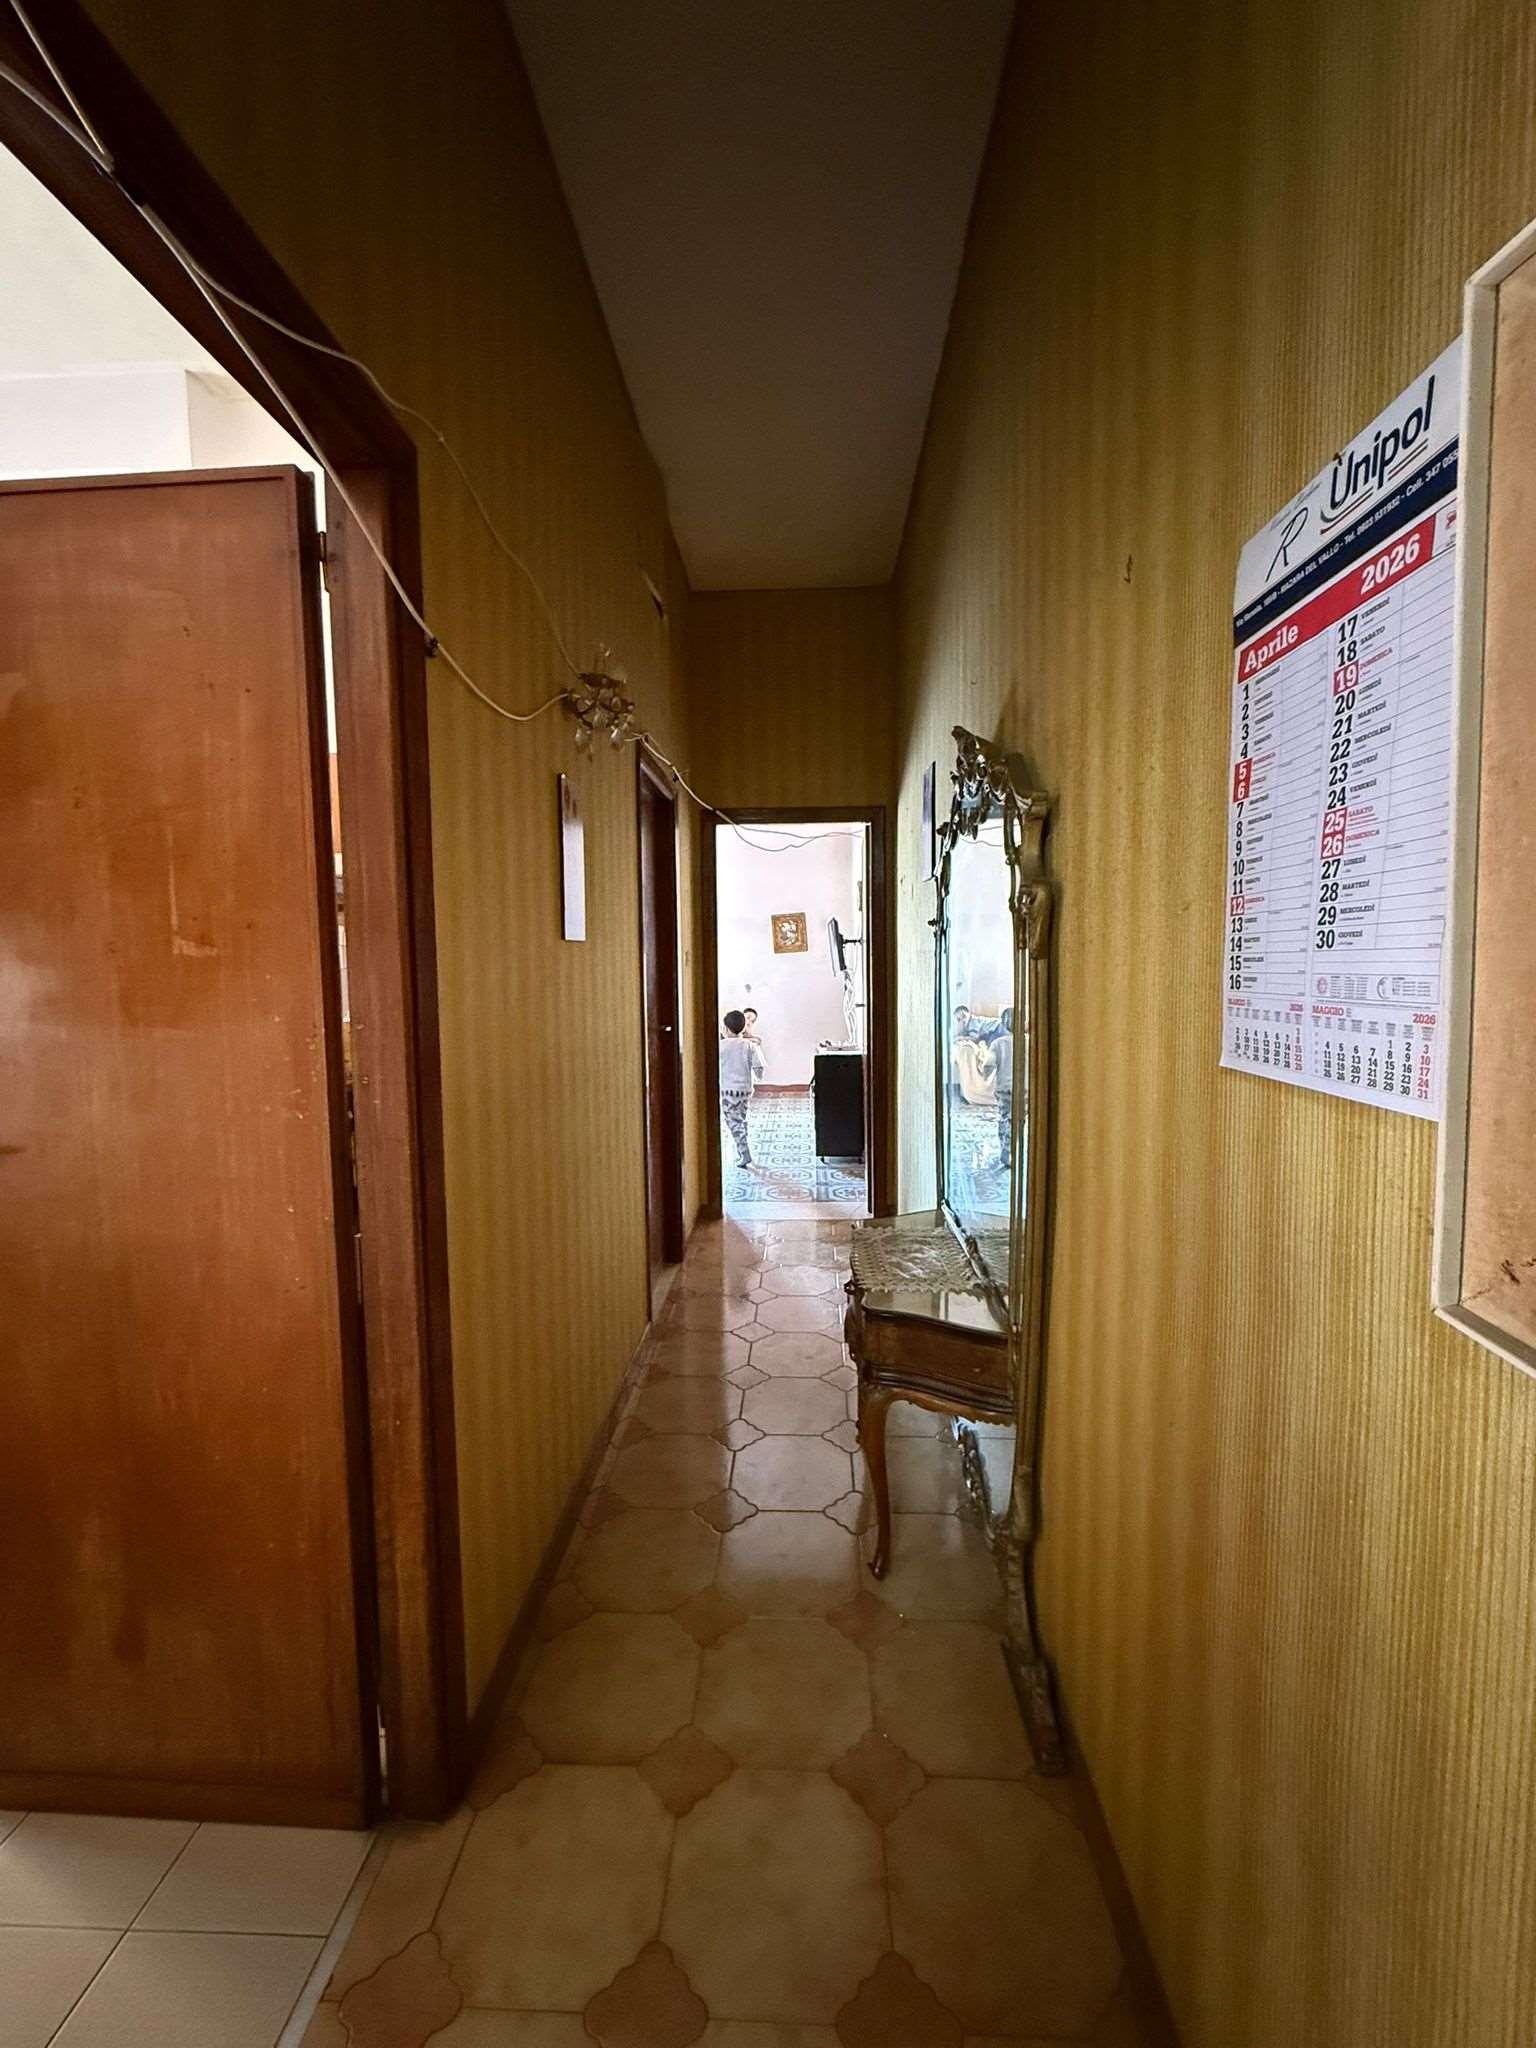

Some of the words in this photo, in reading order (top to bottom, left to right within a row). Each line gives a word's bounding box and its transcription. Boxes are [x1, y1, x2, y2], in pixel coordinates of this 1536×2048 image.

[1330, 375, 1435, 510] Unipol
[1244, 625, 1299, 673] Aprile
[1360, 533, 1420, 595] 2026
[1338, 614, 1357, 643] 17
[1337, 641, 1357, 667] 18
[1337, 666, 1357, 691] 19
[1243, 684, 1248, 700] 1
[1335, 690, 1355, 716] 20
[1242, 704, 1249, 721] 2
[1242, 724, 1249, 740] 3
[1332, 715, 1352, 739] 21
[1241, 743, 1248, 759] 4
[1330, 739, 1350, 762] 22
[1239, 763, 1247, 780] 5
[1329, 763, 1348, 786] 23
[1238, 783, 1244, 798] 6
[1328, 787, 1346, 810] 24
[1237, 802, 1244, 817] 7
[1236, 822, 1242, 837] 8
[1325, 811, 1344, 833] 25
[1236, 841, 1242, 856] 9
[1323, 834, 1342, 857] 26
[1233, 860, 1244, 876] 10
[1321, 859, 1340, 880] 27
[1233, 879, 1243, 895] 11
[1320, 883, 1339, 902] 28
[1232, 899, 1243, 914] 12
[1318, 906, 1336, 925] 29
[1232, 917, 1243, 933] 13
[1230, 936, 1242, 952] 14
[1317, 930, 1335, 948] 30
[1230, 956, 1241, 970] 15
[1230, 975, 1241, 990] 16
[1413, 1013, 1436, 1025] 2026
[1326, 1041, 1330, 1049] 4
[1339, 1043, 1343, 1052] 5
[1354, 1046, 1359, 1054] 6
[1370, 1048, 1375, 1057] 7
[1387, 1050, 1392, 1060] 8
[1405, 1053, 1410, 1062] 9
[1421, 1056, 1430, 1066] 10
[1388, 1040, 1392, 1049] 1
[1405, 1042, 1411, 1051] 2
[1424, 1045, 1429, 1055] 3
[1324, 1051, 1331, 1059] 11
[1337, 1053, 1345, 1061] 12
[1352, 1055, 1360, 1064] 13
[1368, 1058, 1377, 1068] 14
[1385, 1061, 1394, 1070] 15
[1403, 1064, 1412, 1074] 16
[1420, 1067, 1430, 1077] 17
[1351, 1065, 1360, 1074] 20
[1368, 1069, 1376, 1078] 21
[1384, 1071, 1394, 1081] 22
[1401, 1074, 1411, 1085] 23
[1418, 1078, 1428, 1088] 24
[1351, 1075, 1360, 1084] 27
[1368, 1078, 1376, 1088] 28
[1384, 1082, 1393, 1091] 29
[1401, 1086, 1410, 1096] 30
[1418, 1089, 1428, 1099] 31
